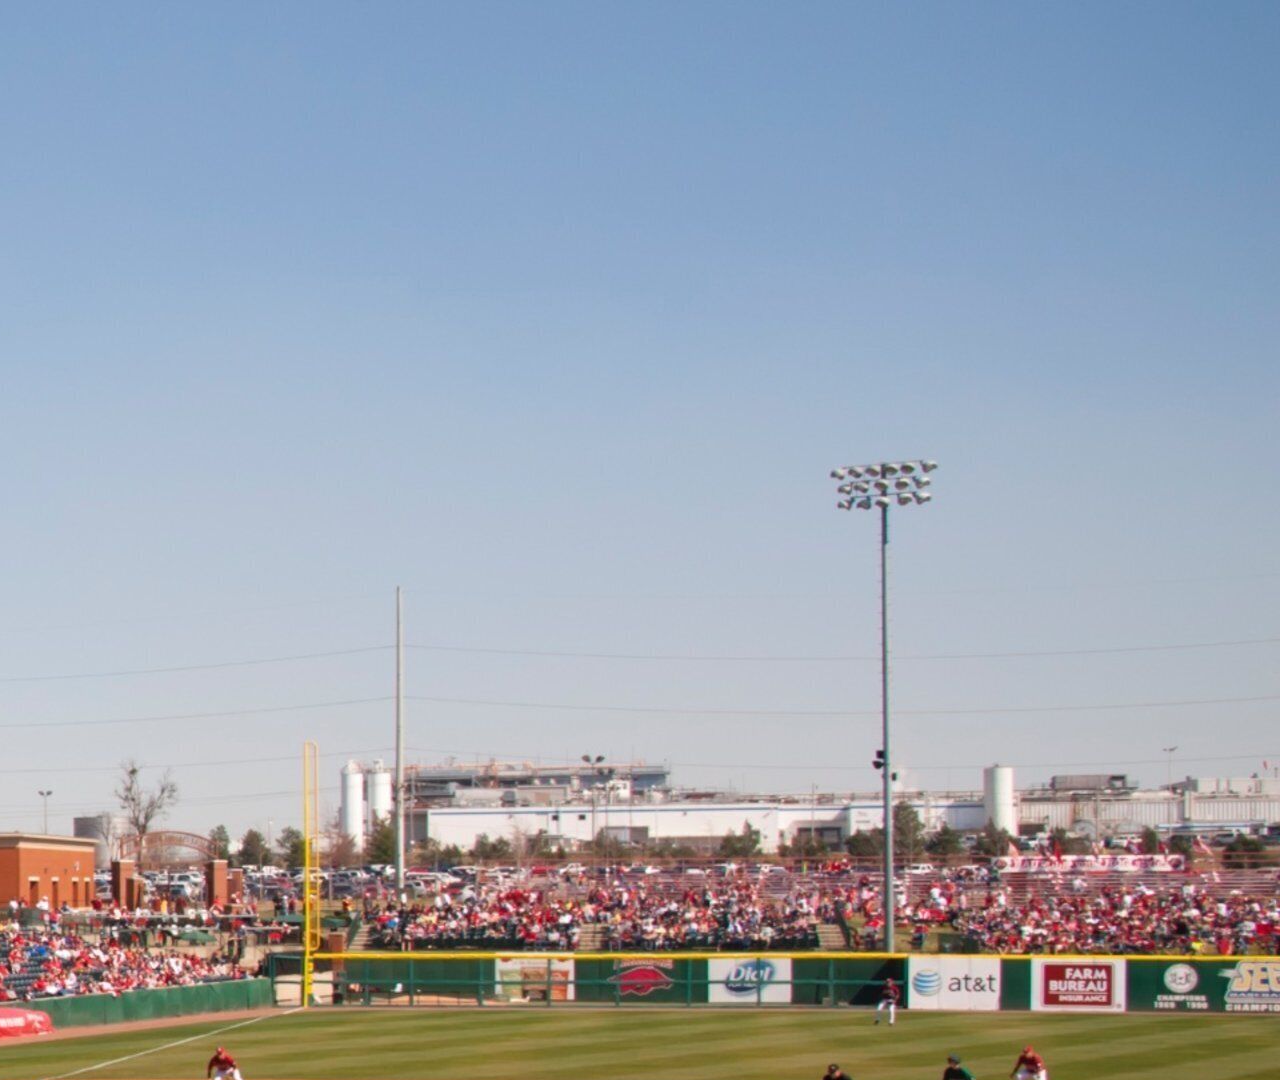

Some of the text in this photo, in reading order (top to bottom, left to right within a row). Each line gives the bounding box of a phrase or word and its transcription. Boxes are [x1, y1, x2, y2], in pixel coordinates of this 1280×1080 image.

[1065, 968, 1107, 979] FARM
[948, 975, 997, 993] at&t
[1049, 980, 1107, 992] BUREAU
[1058, 995, 1107, 1003] INSURANCE
